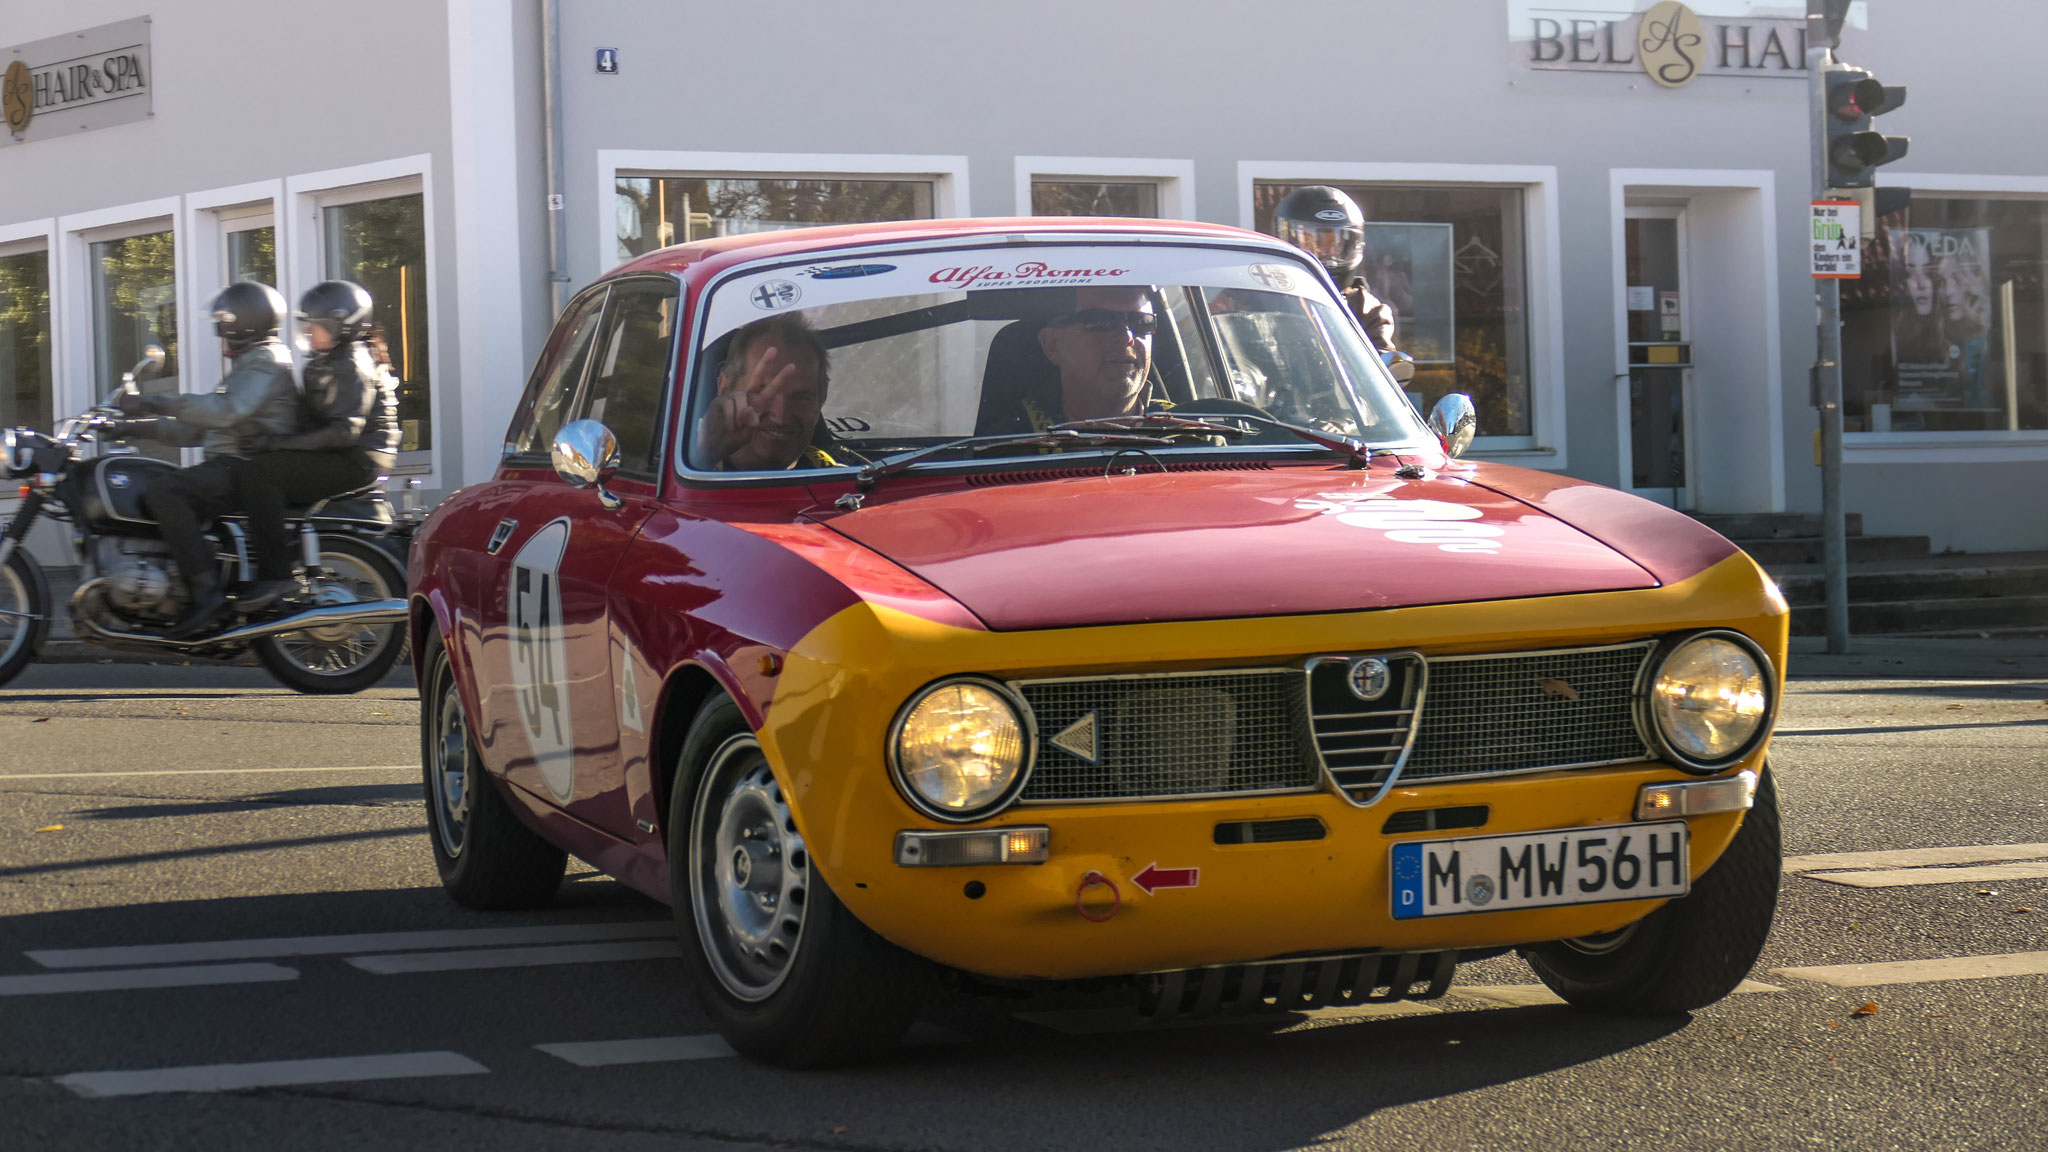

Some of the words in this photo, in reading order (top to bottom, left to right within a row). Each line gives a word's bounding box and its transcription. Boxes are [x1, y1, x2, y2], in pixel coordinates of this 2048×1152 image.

[1529, 17, 1633, 64] BEL
[1716, 24, 1839, 70] HAI
[602, 50, 613, 71] 4
[1014, 261, 1131, 279] Romeo
[977, 279, 1014, 288] SUPER
[1017, 278, 1094, 286] PRODUZIONE
[1401, 889, 1415, 906] D
